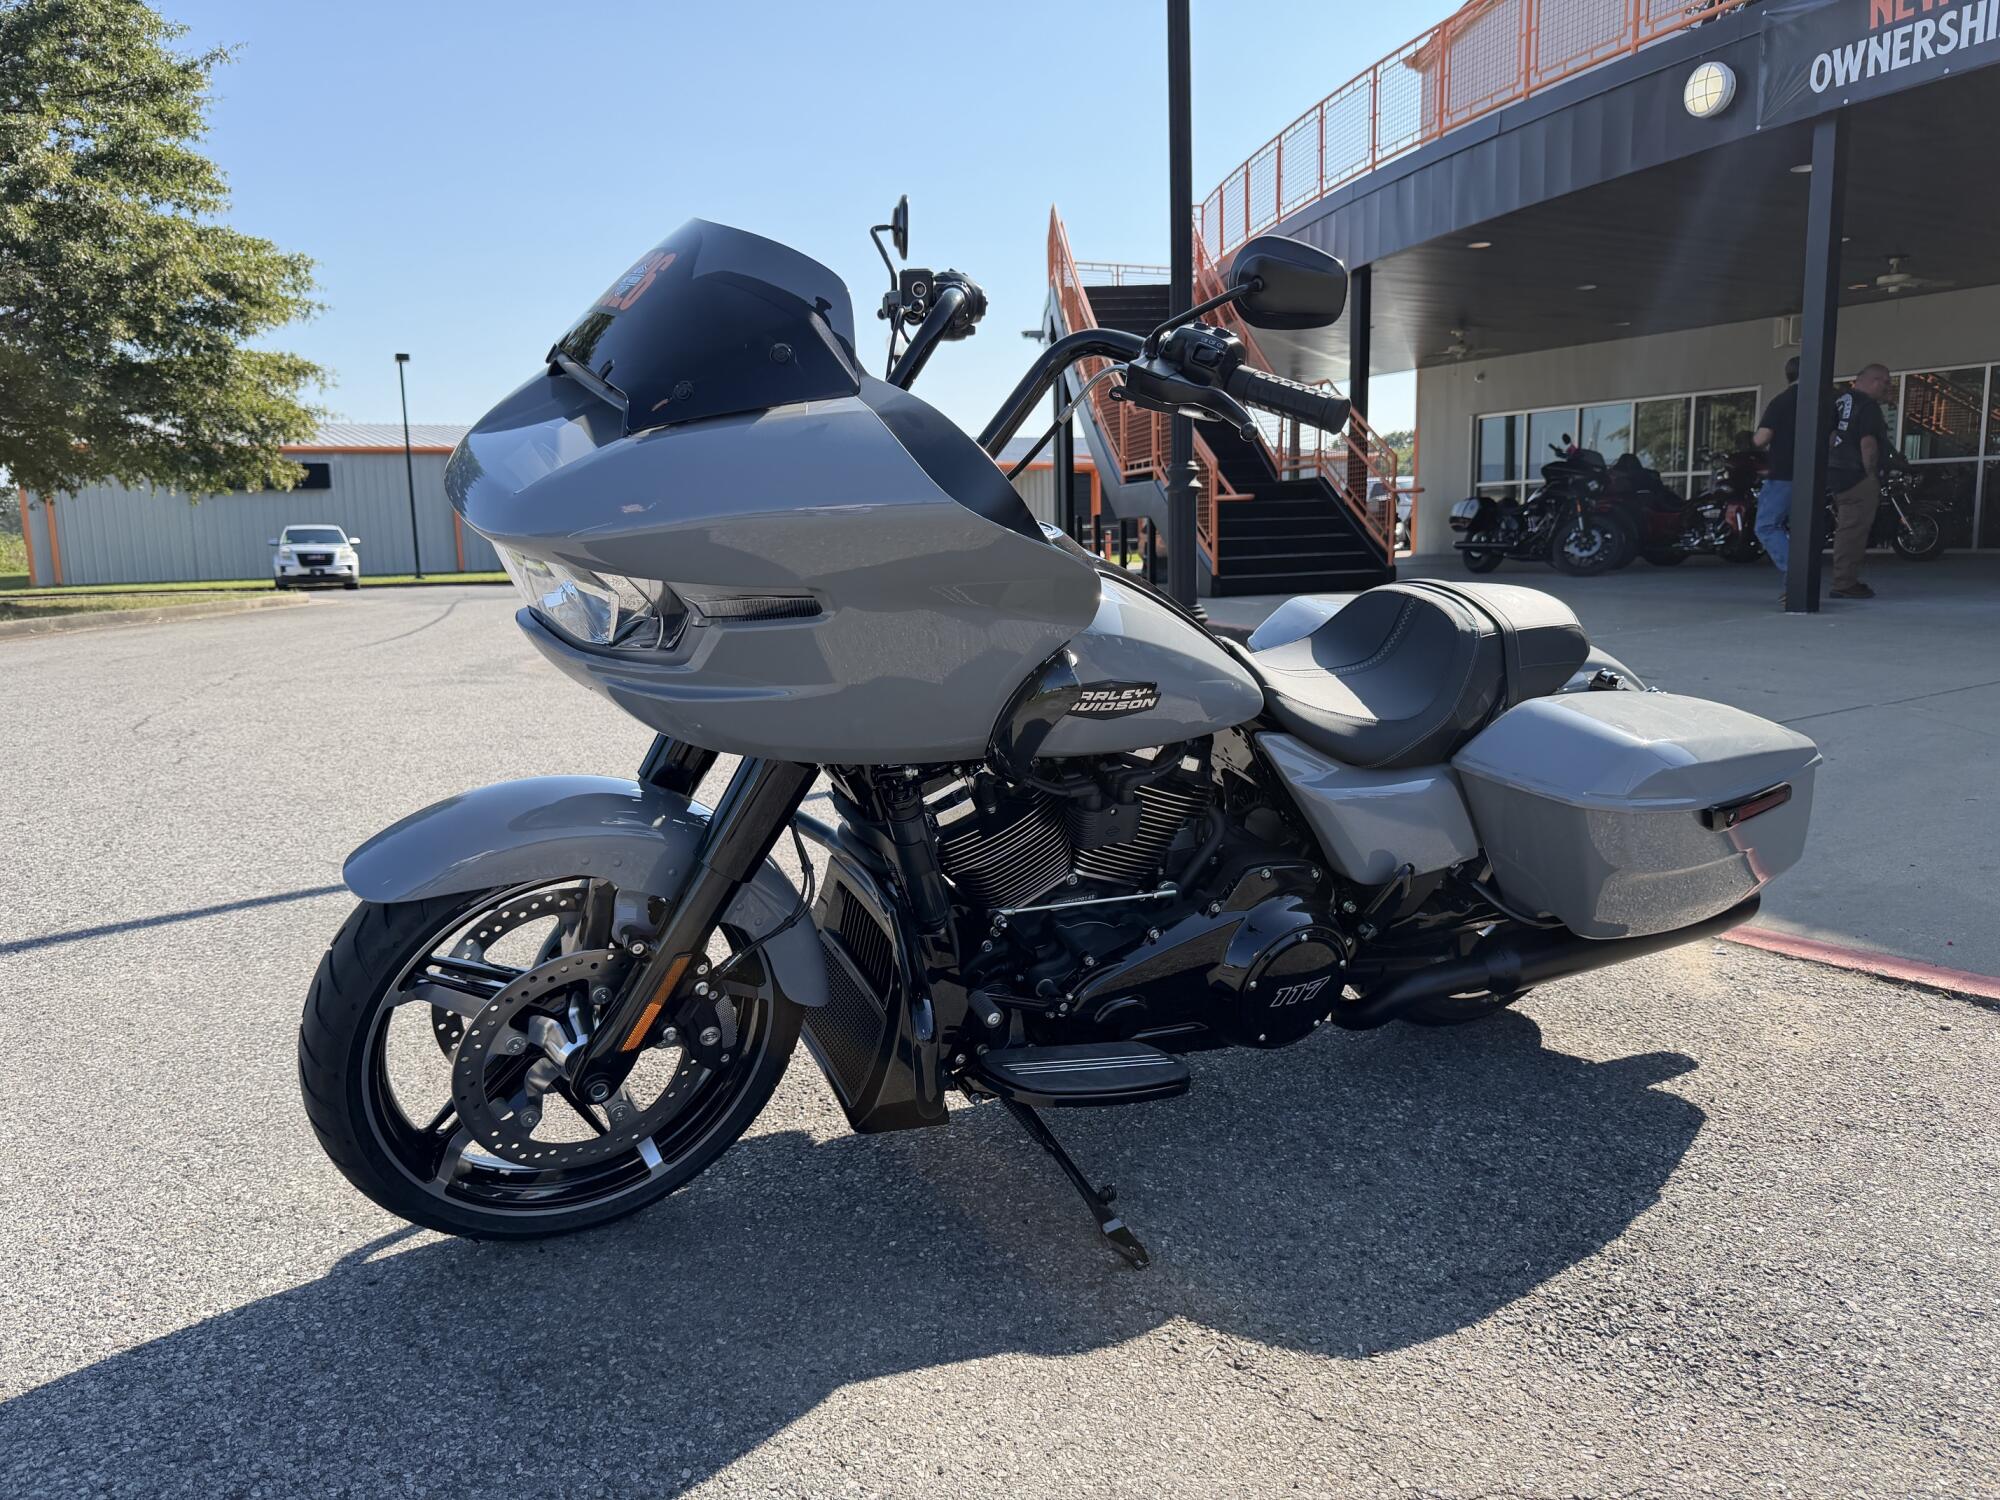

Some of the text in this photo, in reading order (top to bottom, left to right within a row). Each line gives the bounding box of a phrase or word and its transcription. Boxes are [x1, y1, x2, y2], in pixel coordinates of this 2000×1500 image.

[1869, 0, 1949, 30] NE
[1809, 0, 2000, 93] OWNERSHI
[1071, 697, 1157, 712] VIDSON
[1081, 688, 1153, 701] ARLEY-
[1269, 975, 1332, 1008] 117
